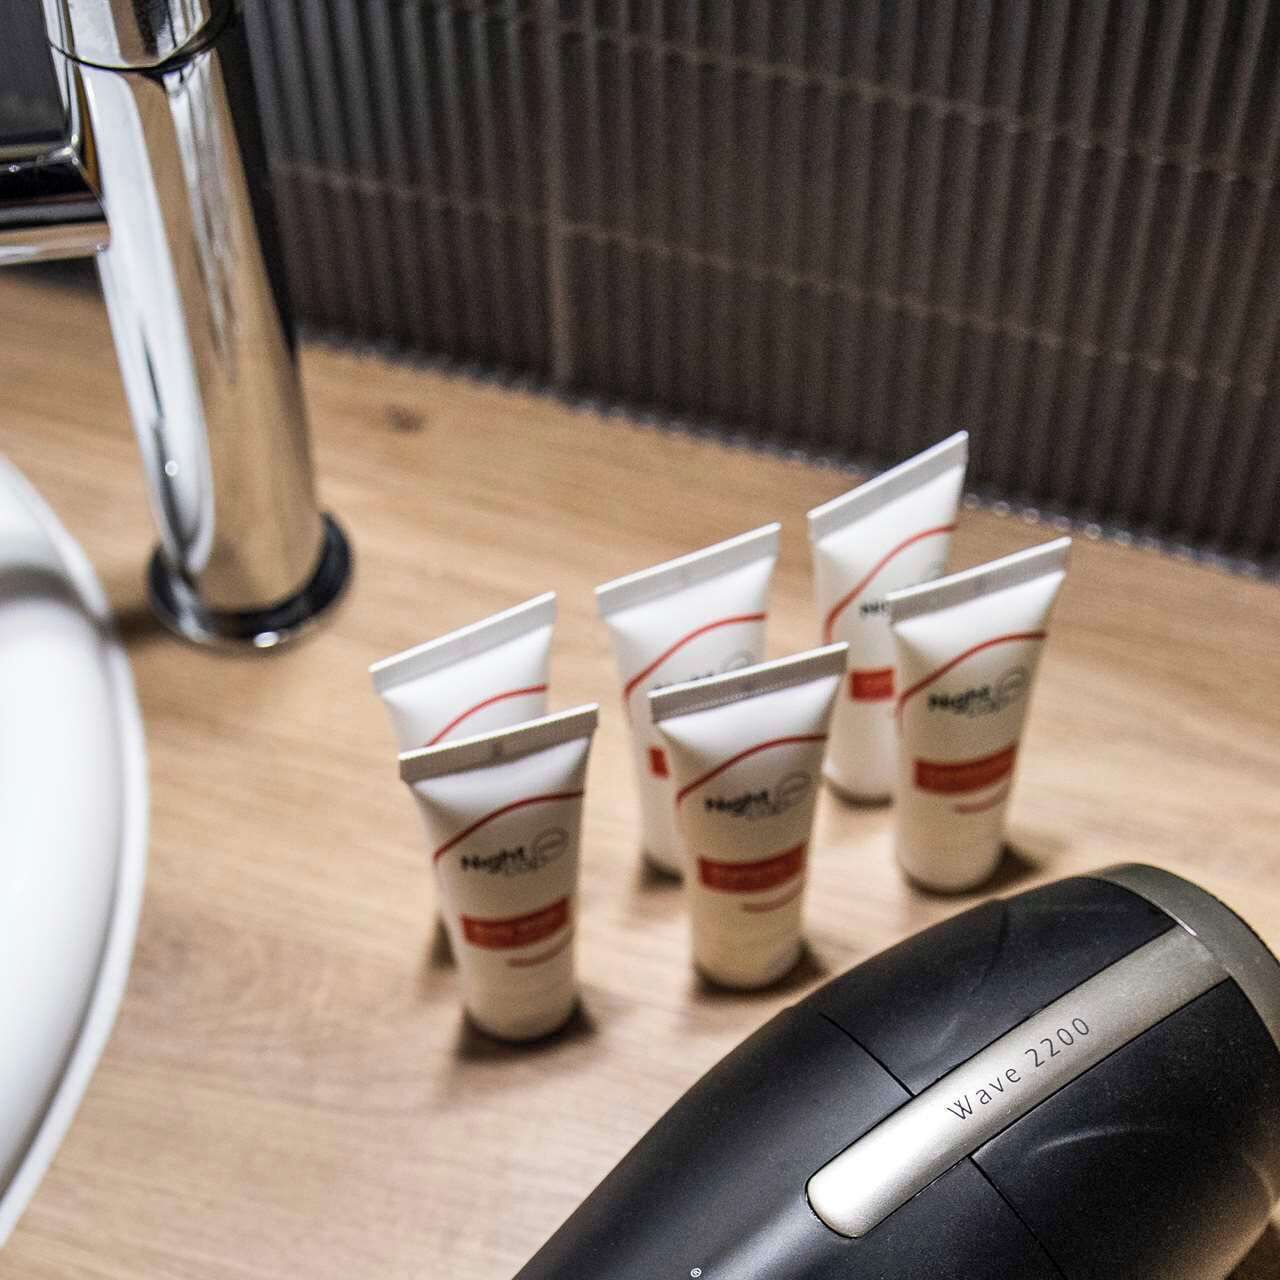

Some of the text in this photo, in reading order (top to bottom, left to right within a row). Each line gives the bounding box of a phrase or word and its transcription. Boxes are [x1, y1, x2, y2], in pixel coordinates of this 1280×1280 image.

[461, 846, 525, 874] Night
[946, 1017, 1090, 1121] Wave 2200
